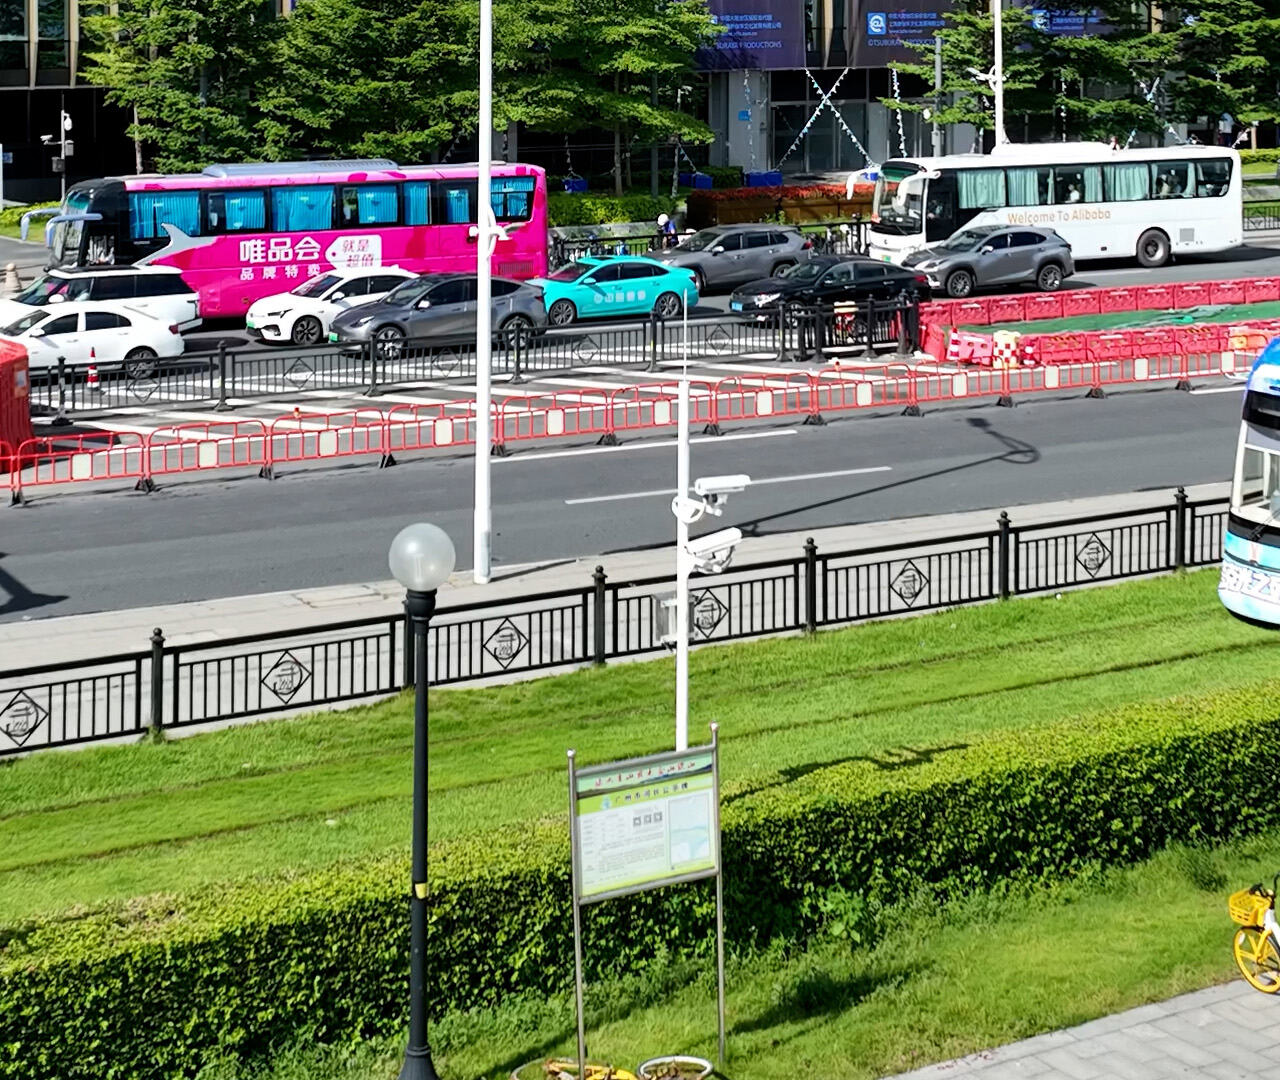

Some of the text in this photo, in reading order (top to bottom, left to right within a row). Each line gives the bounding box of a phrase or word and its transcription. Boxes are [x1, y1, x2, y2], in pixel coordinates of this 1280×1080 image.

[1007, 208, 1111, 224] Welcome To Alibaba
[239, 235, 322, 264] 唯品会
[342, 239, 370, 252] 就是
[346, 253, 374, 268] 超值
[239, 264, 321, 281] 品牌特卖
